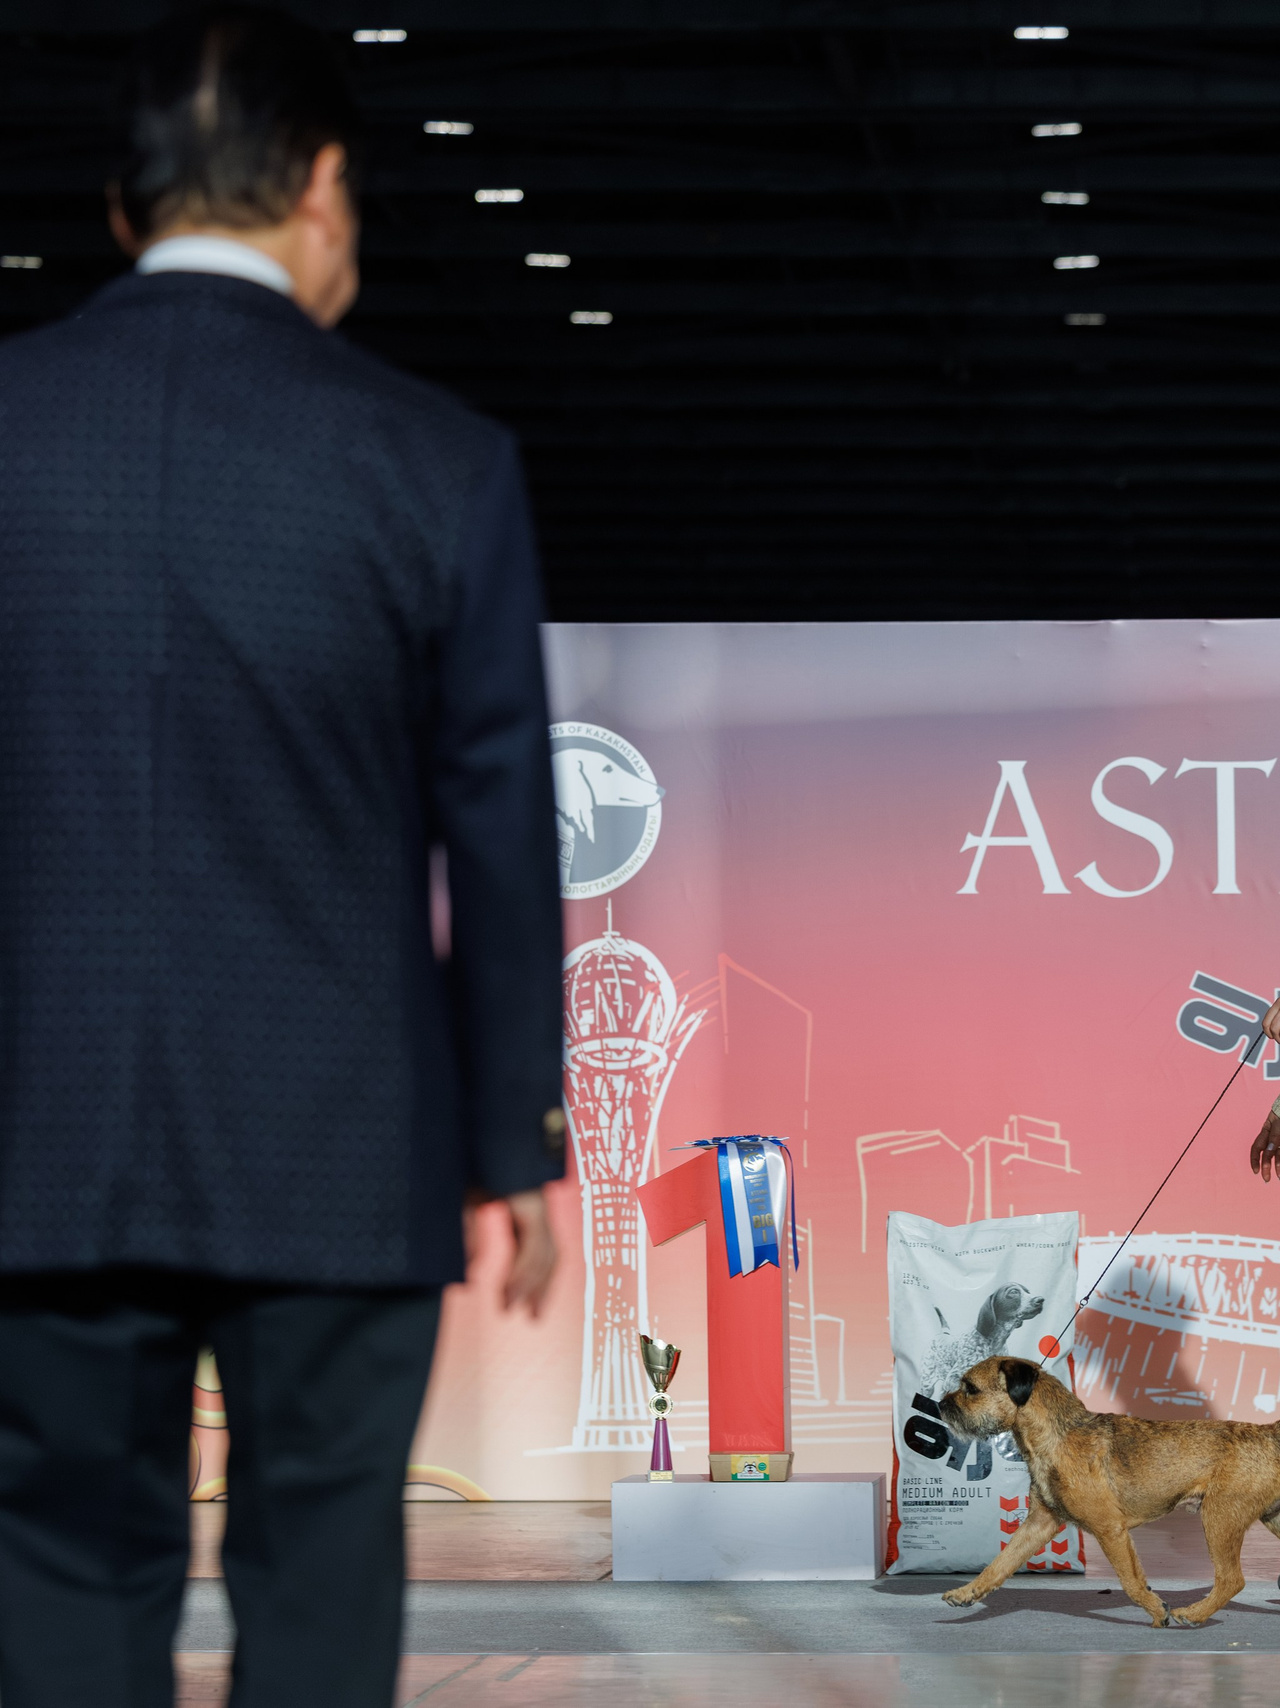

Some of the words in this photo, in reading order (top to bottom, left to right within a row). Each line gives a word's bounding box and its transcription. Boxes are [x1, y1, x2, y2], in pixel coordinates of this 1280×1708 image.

[568, 726, 583, 734] OF
[585, 726, 647, 774] KAZAKHSTAN
[752, 1213, 774, 1228] BIG
[954, 1249, 970, 1257] WITH
[973, 1244, 1006, 1254] BUCKWHEAT
[635, 1146, 791, 1452] 1
[902, 1487, 943, 1498] MEDIUM
[952, 1487, 992, 1498] ADULT
